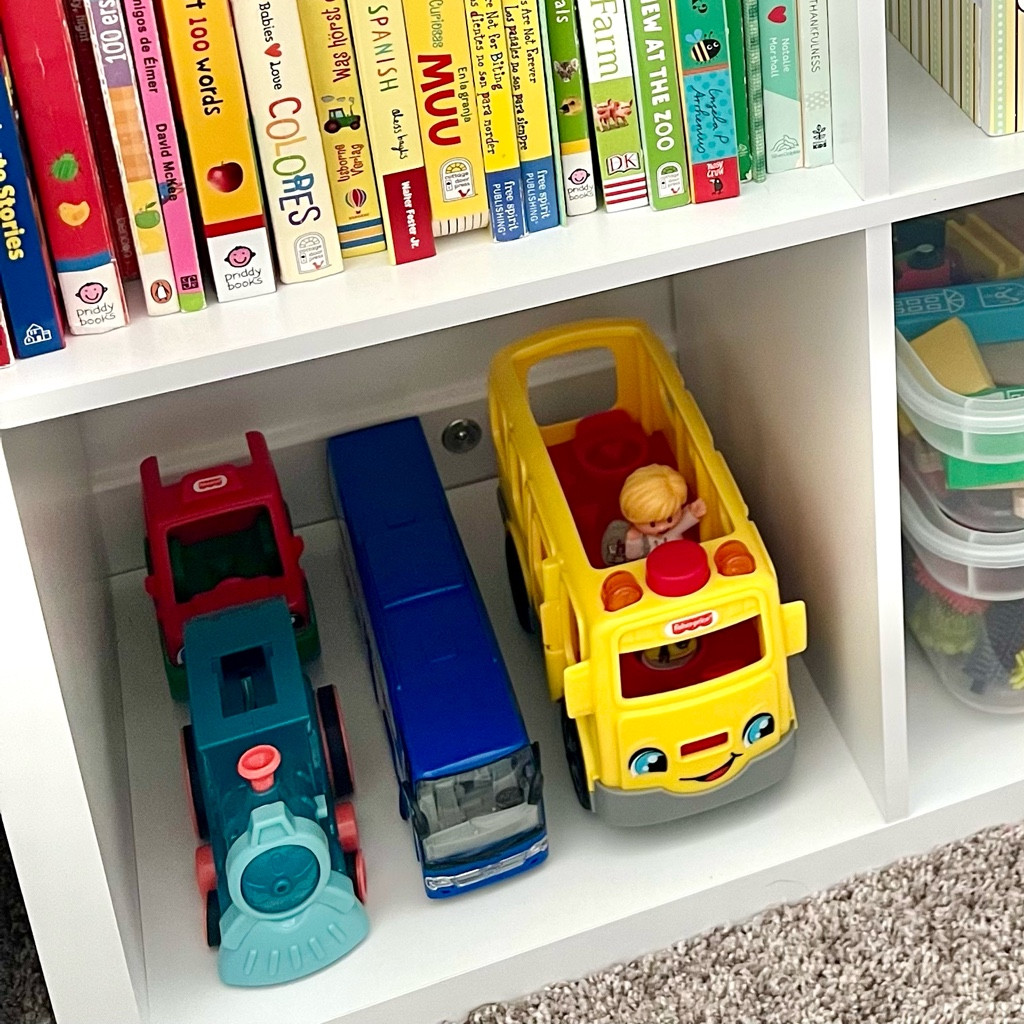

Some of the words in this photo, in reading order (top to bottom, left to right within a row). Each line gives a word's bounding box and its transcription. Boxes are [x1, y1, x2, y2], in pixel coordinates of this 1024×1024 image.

[259, 1, 275, 43] Babies
[321, 6, 348, 48] hörst
[428, 0, 444, 48] Curiosas
[486, 10, 499, 31] Not
[504, 5, 519, 23] Los
[522, 8, 533, 22] Are
[140, 37, 150, 52] de
[189, 17, 209, 52] 100
[470, 10, 485, 51] dientes
[523, 22, 536, 45] Not
[100, 29, 126, 64] 100
[476, 54, 485, 67] no
[645, 40, 665, 61] AT
[769, 37, 779, 78] Marshall
[781, 38, 791, 72] Natalie
[144, 57, 158, 93] Élmer
[333, 51, 351, 83] Was
[458, 67, 467, 79] En
[490, 52, 504, 91] Biting
[509, 62, 519, 75] no
[527, 47, 538, 84] Forever
[196, 57, 223, 115] words
[461, 81, 469, 90] la
[477, 71, 488, 89] son
[510, 77, 521, 91] son
[649, 66, 670, 106] THE
[417, 54, 461, 145] MUU
[458, 90, 470, 123] granja
[477, 92, 492, 115] para
[512, 93, 527, 116] para
[156, 123, 172, 157] David
[516, 116, 528, 150] siempre
[654, 110, 674, 151] ZOO
[266, 97, 321, 225] COLORES
[349, 143, 364, 177] Verlag
[609, 155, 637, 173] DK
[163, 161, 177, 201] McKee
[401, 180, 412, 208] Walter
[504, 181, 515, 201] free
[537, 170, 548, 190] free
[492, 183, 504, 234] PUBLISHING
[526, 173, 537, 223] PUBLISHING
[537, 191, 552, 219] spirit
[569, 192, 594, 201] books
[406, 208, 417, 236] Foster
[504, 203, 519, 232] spirit
[410, 237, 420, 250] Jr.
[225, 268, 261, 283] priddy
[228, 277, 263, 290] books
[76, 303, 115, 317] priddy
[80, 313, 116, 326] books
